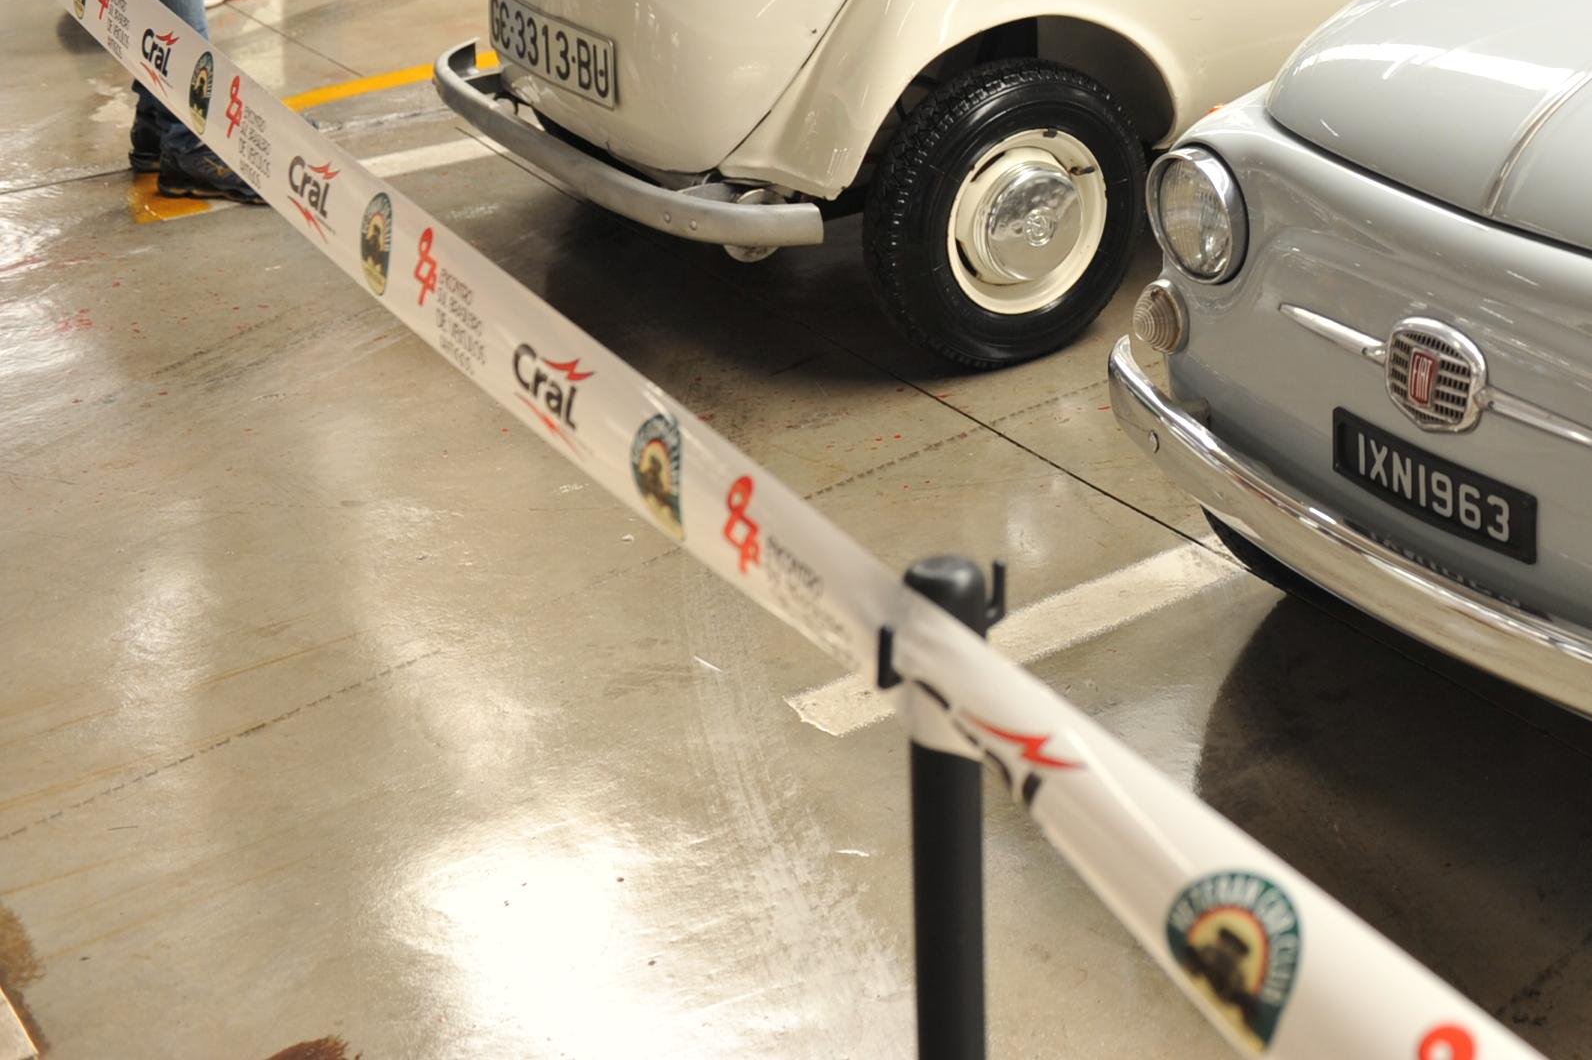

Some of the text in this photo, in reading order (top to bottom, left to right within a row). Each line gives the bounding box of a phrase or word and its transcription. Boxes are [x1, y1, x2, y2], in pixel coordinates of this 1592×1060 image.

[142, 28, 171, 77] Cral
[289, 156, 331, 218] Cral
[512, 343, 578, 430] Cral
[1411, 355, 1433, 402] FIAT
